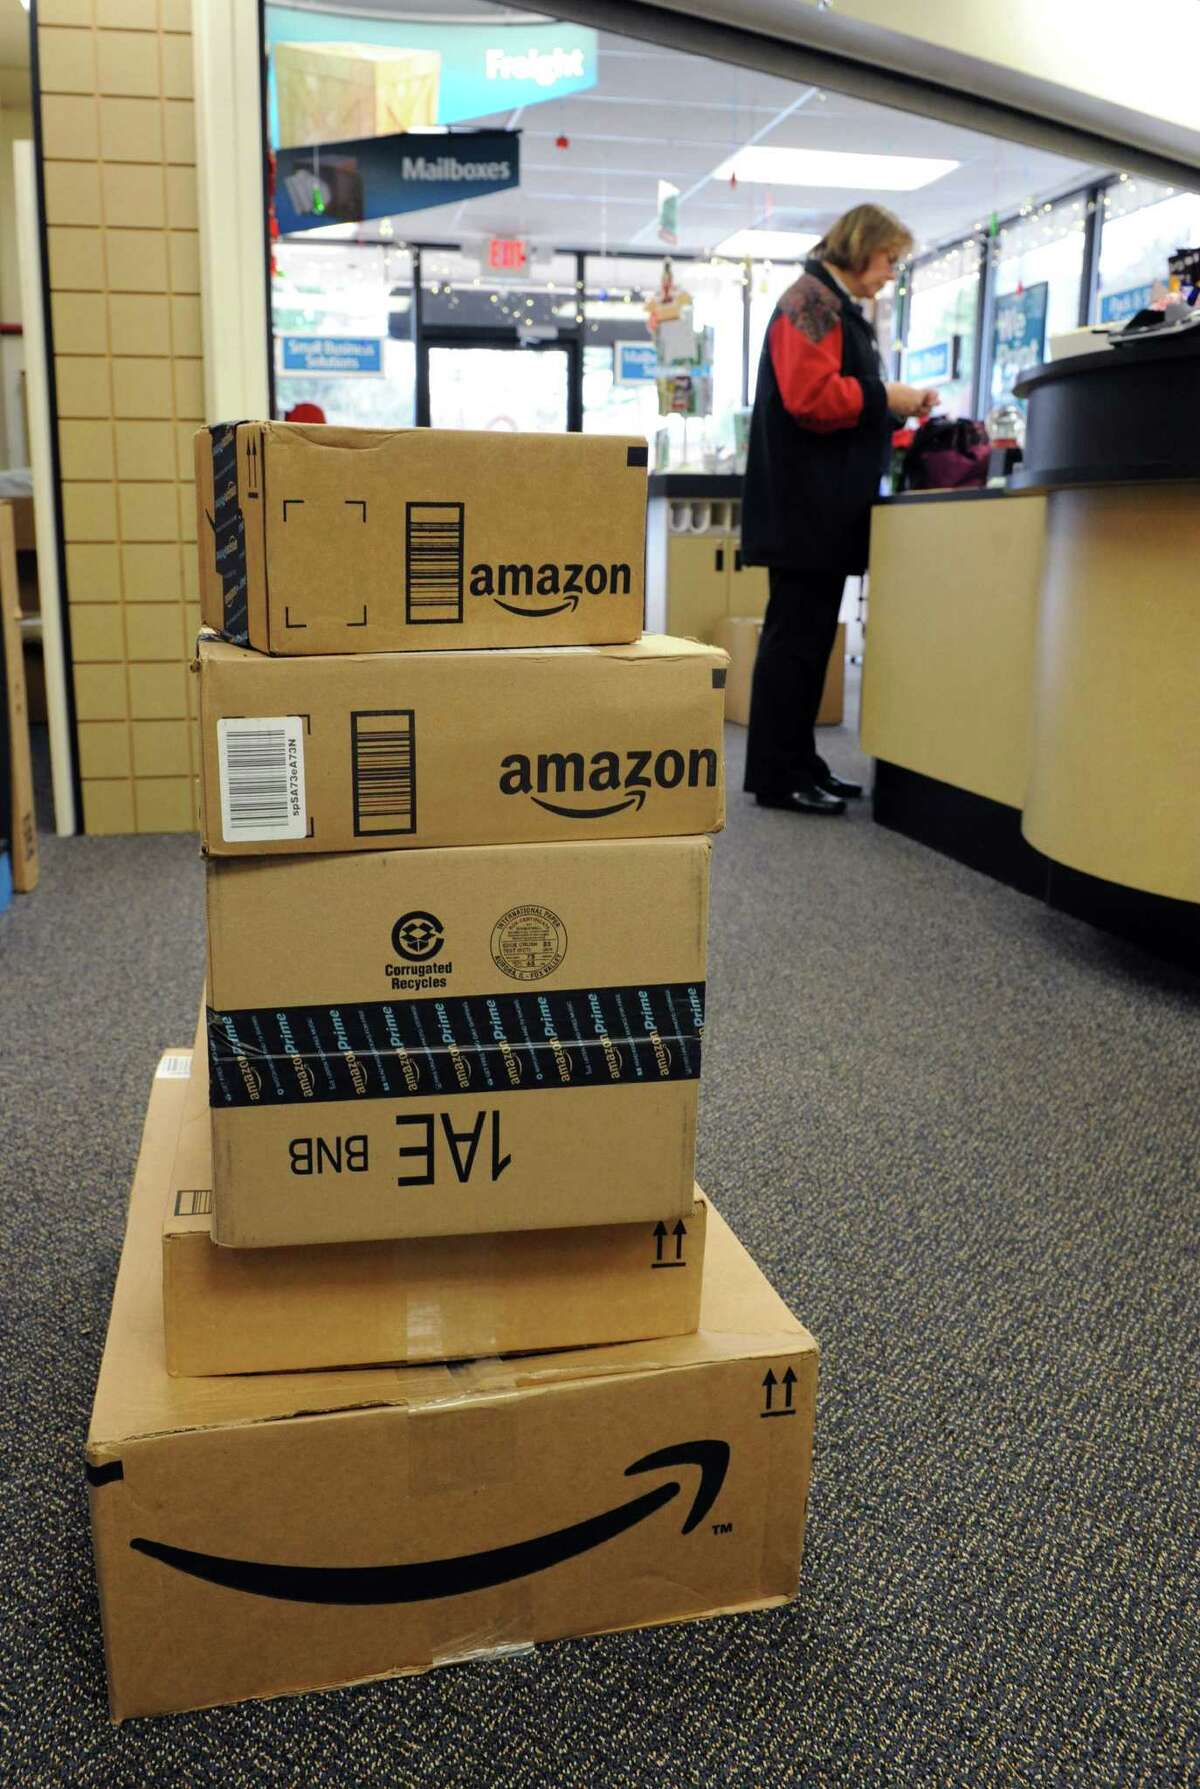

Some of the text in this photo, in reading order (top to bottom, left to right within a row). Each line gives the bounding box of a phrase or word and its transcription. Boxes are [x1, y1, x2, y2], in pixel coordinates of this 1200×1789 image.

[485, 48, 583, 86] Freight
[402, 156, 511, 181] Mailboxes
[490, 239, 523, 270] EXIT
[469, 562, 632, 596] amazon
[499, 748, 718, 795] amazon
[385, 962, 453, 978] Corrugated
[391, 976, 447, 991] Recycles
[382, 1005, 405, 1047] Prime
[687, 986, 705, 1026] Prime
[275, 1012, 300, 1055] Prime
[329, 1008, 353, 1051] Prime
[434, 1002, 470, 1088] amazon Prime
[486, 998, 521, 1086] amazon Prime
[537, 996, 571, 1082] amazon Prime
[588, 992, 621, 1079] amazon Prime
[638, 990, 670, 1076] amazon Prime
[289, 1110, 512, 1187] 1AE BNB
[712, 1523, 733, 1535] TM
